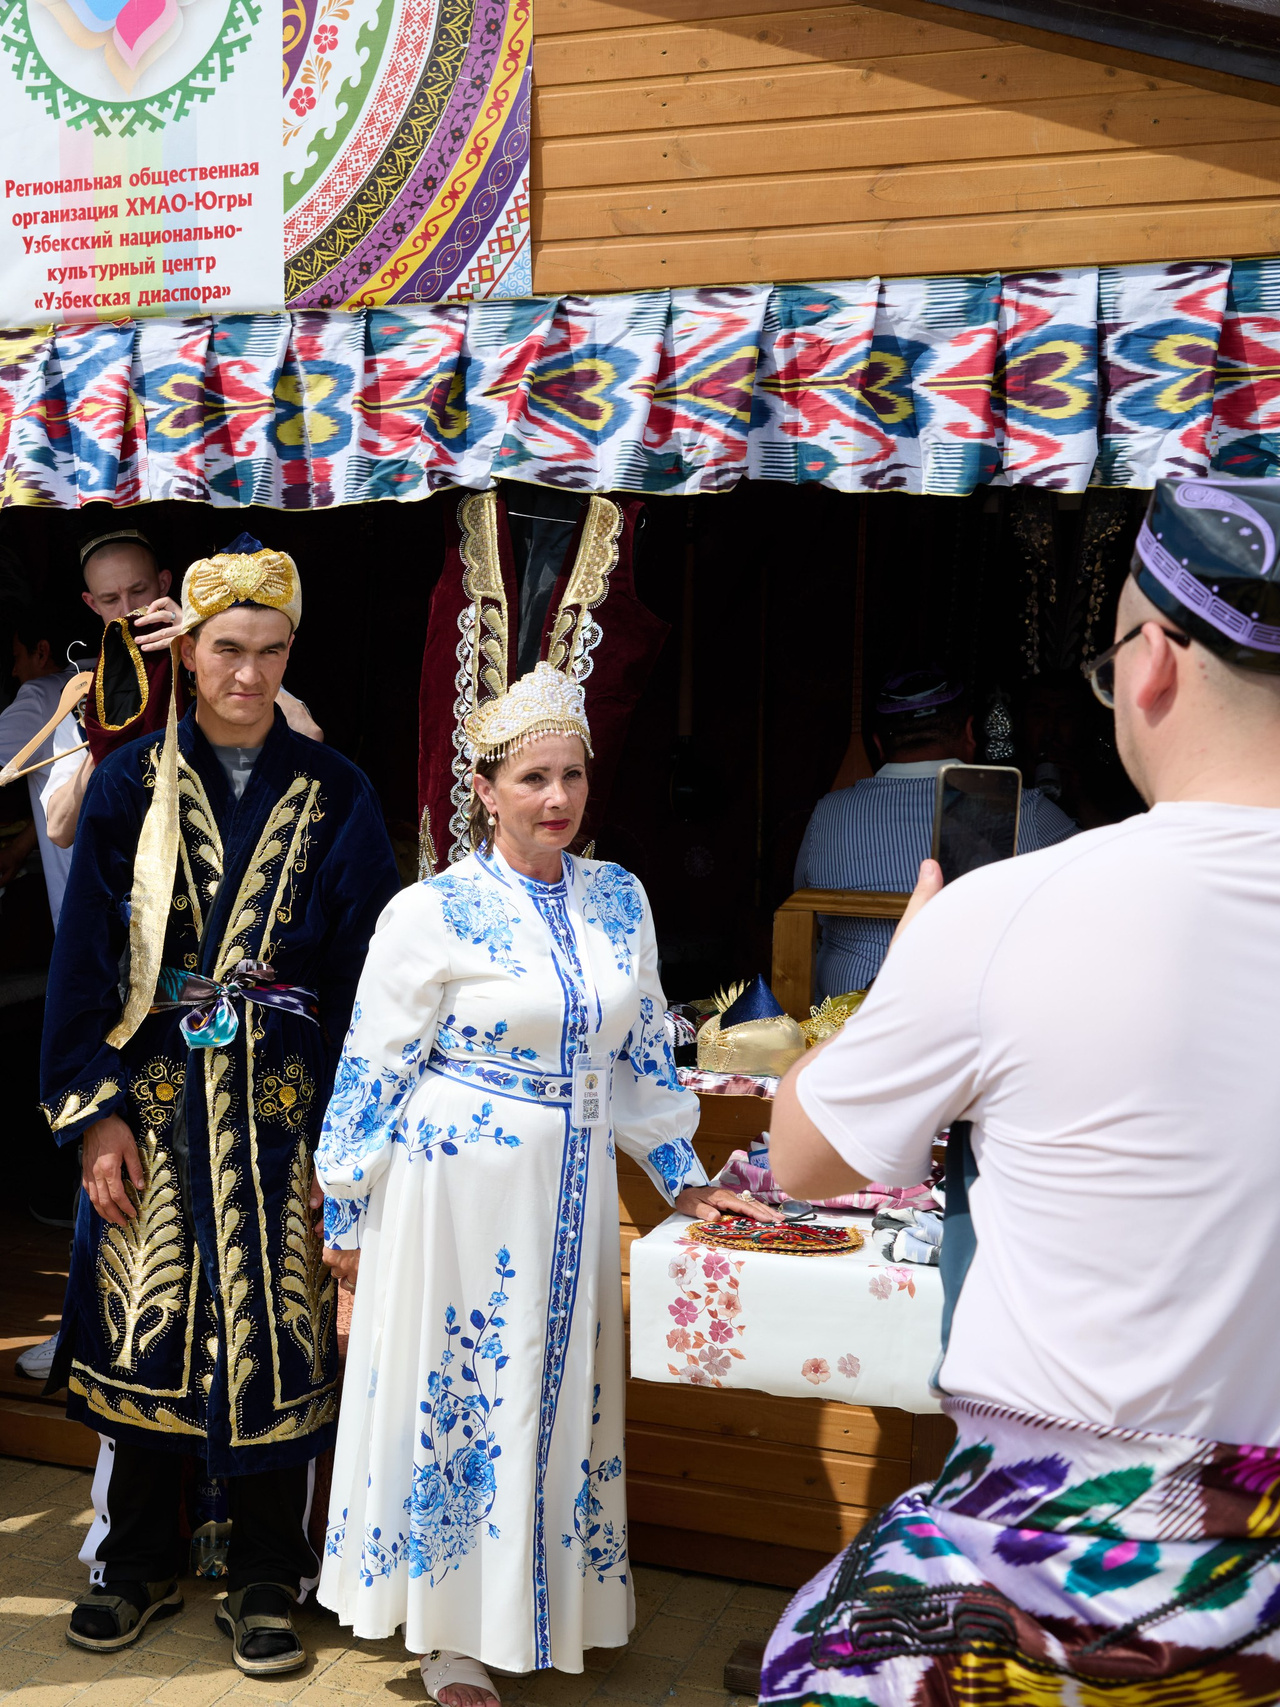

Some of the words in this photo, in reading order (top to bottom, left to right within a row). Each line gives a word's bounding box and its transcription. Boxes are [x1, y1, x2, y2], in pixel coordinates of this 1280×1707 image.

[5, 174, 122, 198] Региональная
[128, 161, 260, 188] общественная
[11, 204, 119, 228] организация
[125, 190, 253, 217] ХМАО-Югры
[22, 230, 114, 255] Узбекский
[119, 224, 243, 248] национально-
[47, 256, 156, 282] культурный
[162, 255, 217, 275] центр
[34, 290, 131, 311] «Узбекская
[137, 285, 231, 308] диаспора»
